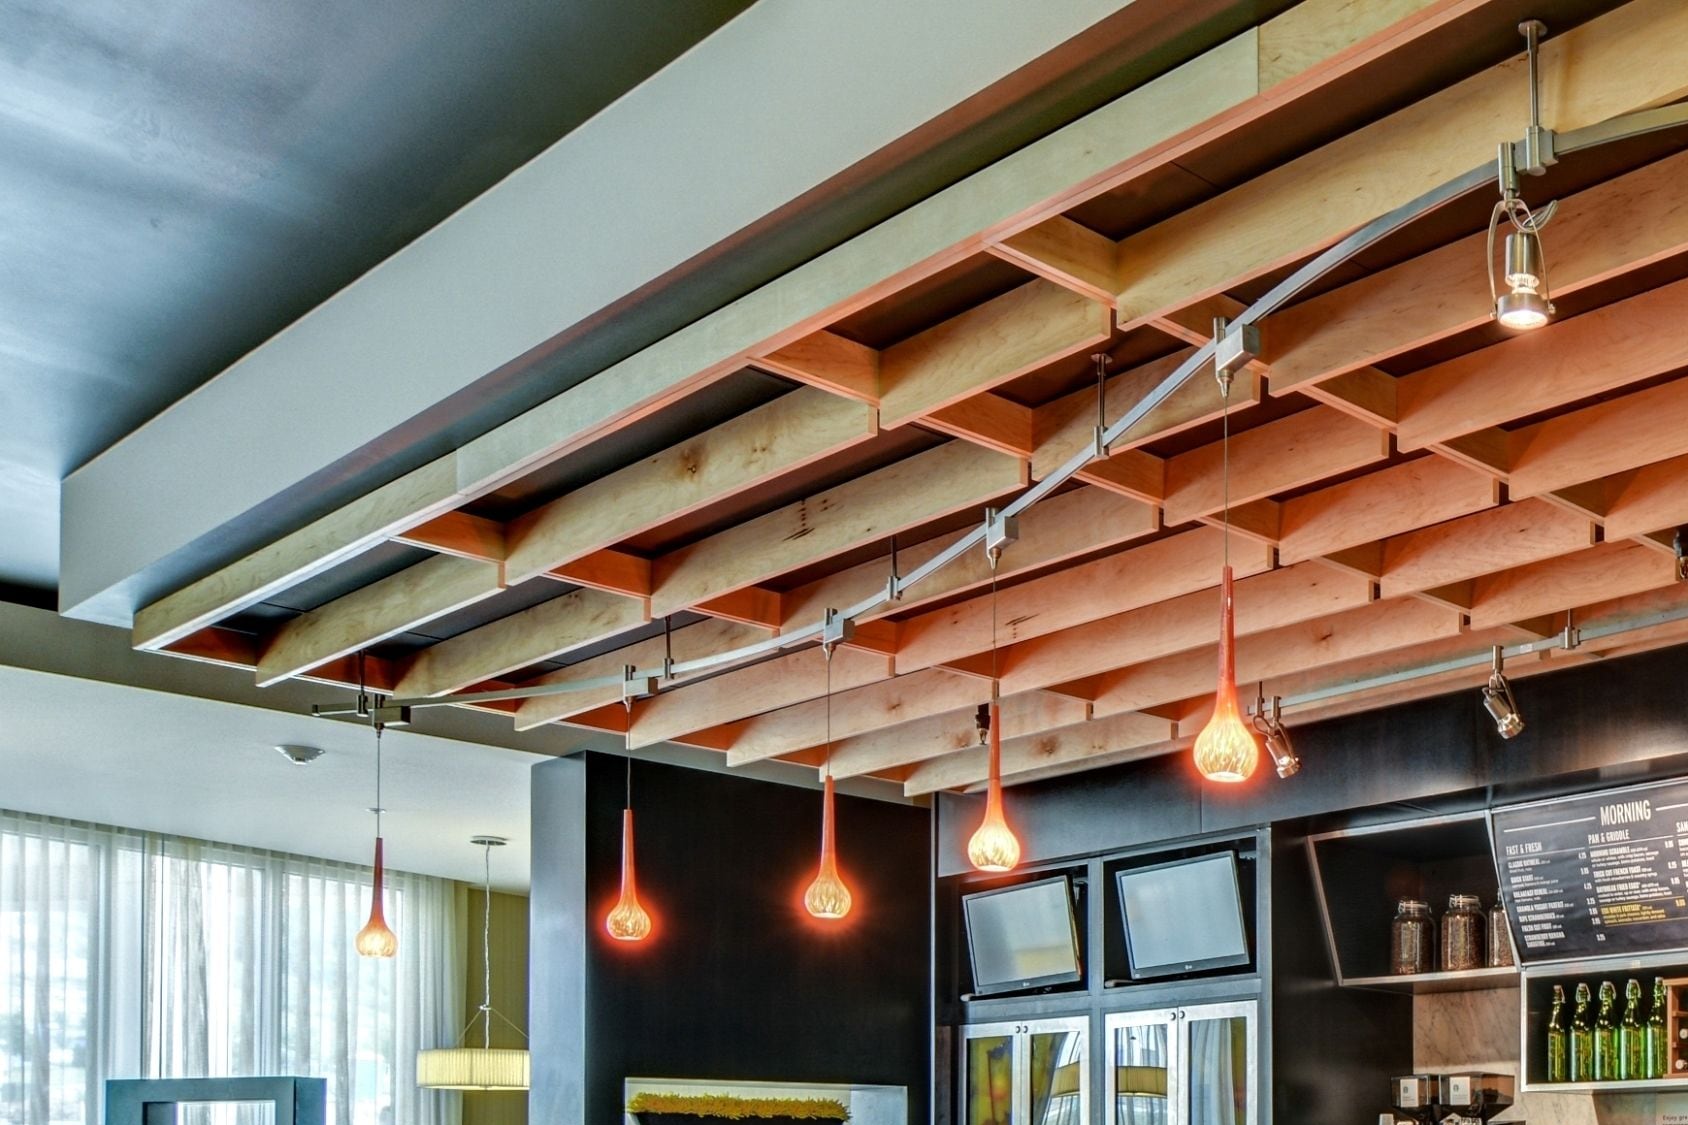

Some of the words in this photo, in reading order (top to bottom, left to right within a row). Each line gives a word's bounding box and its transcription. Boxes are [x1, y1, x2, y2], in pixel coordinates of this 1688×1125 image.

[1600, 800, 1651, 825] MORNING
[1587, 833, 1599, 844] PAN
[1600, 832, 1605, 842] &
[1605, 829, 1629, 842] GRIDDLE
[1505, 844, 1518, 855] FAST
[1519, 843, 1524, 854] &
[1524, 842, 1542, 852] FRESH
